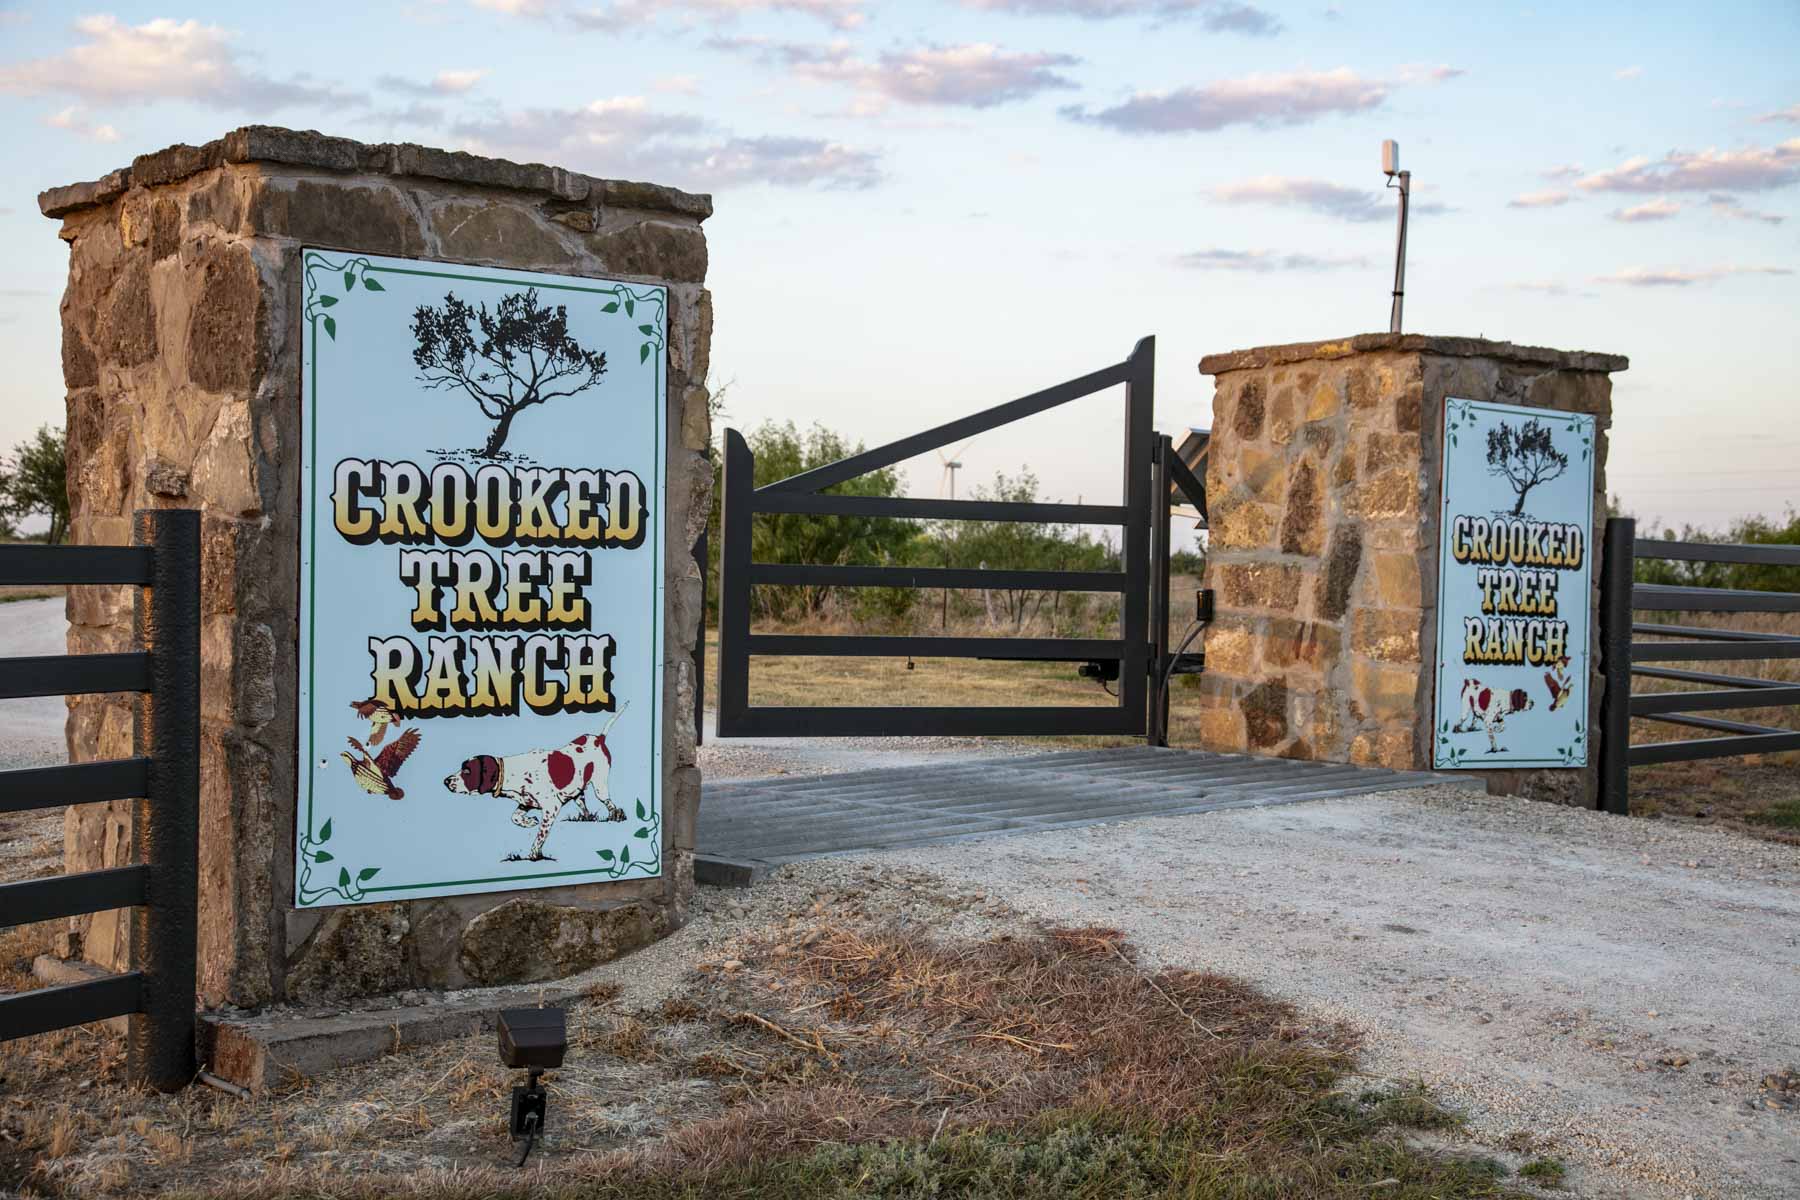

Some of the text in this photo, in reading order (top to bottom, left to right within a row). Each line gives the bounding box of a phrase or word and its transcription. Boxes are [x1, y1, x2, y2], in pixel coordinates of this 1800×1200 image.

[330, 458, 649, 549] CROOKED
[1452, 515, 1585, 570] CROOKED
[400, 549, 592, 632] TREE
[1477, 567, 1558, 617] TREE
[1463, 616, 1568, 667] RANCH
[368, 634, 616, 719] RANCH
